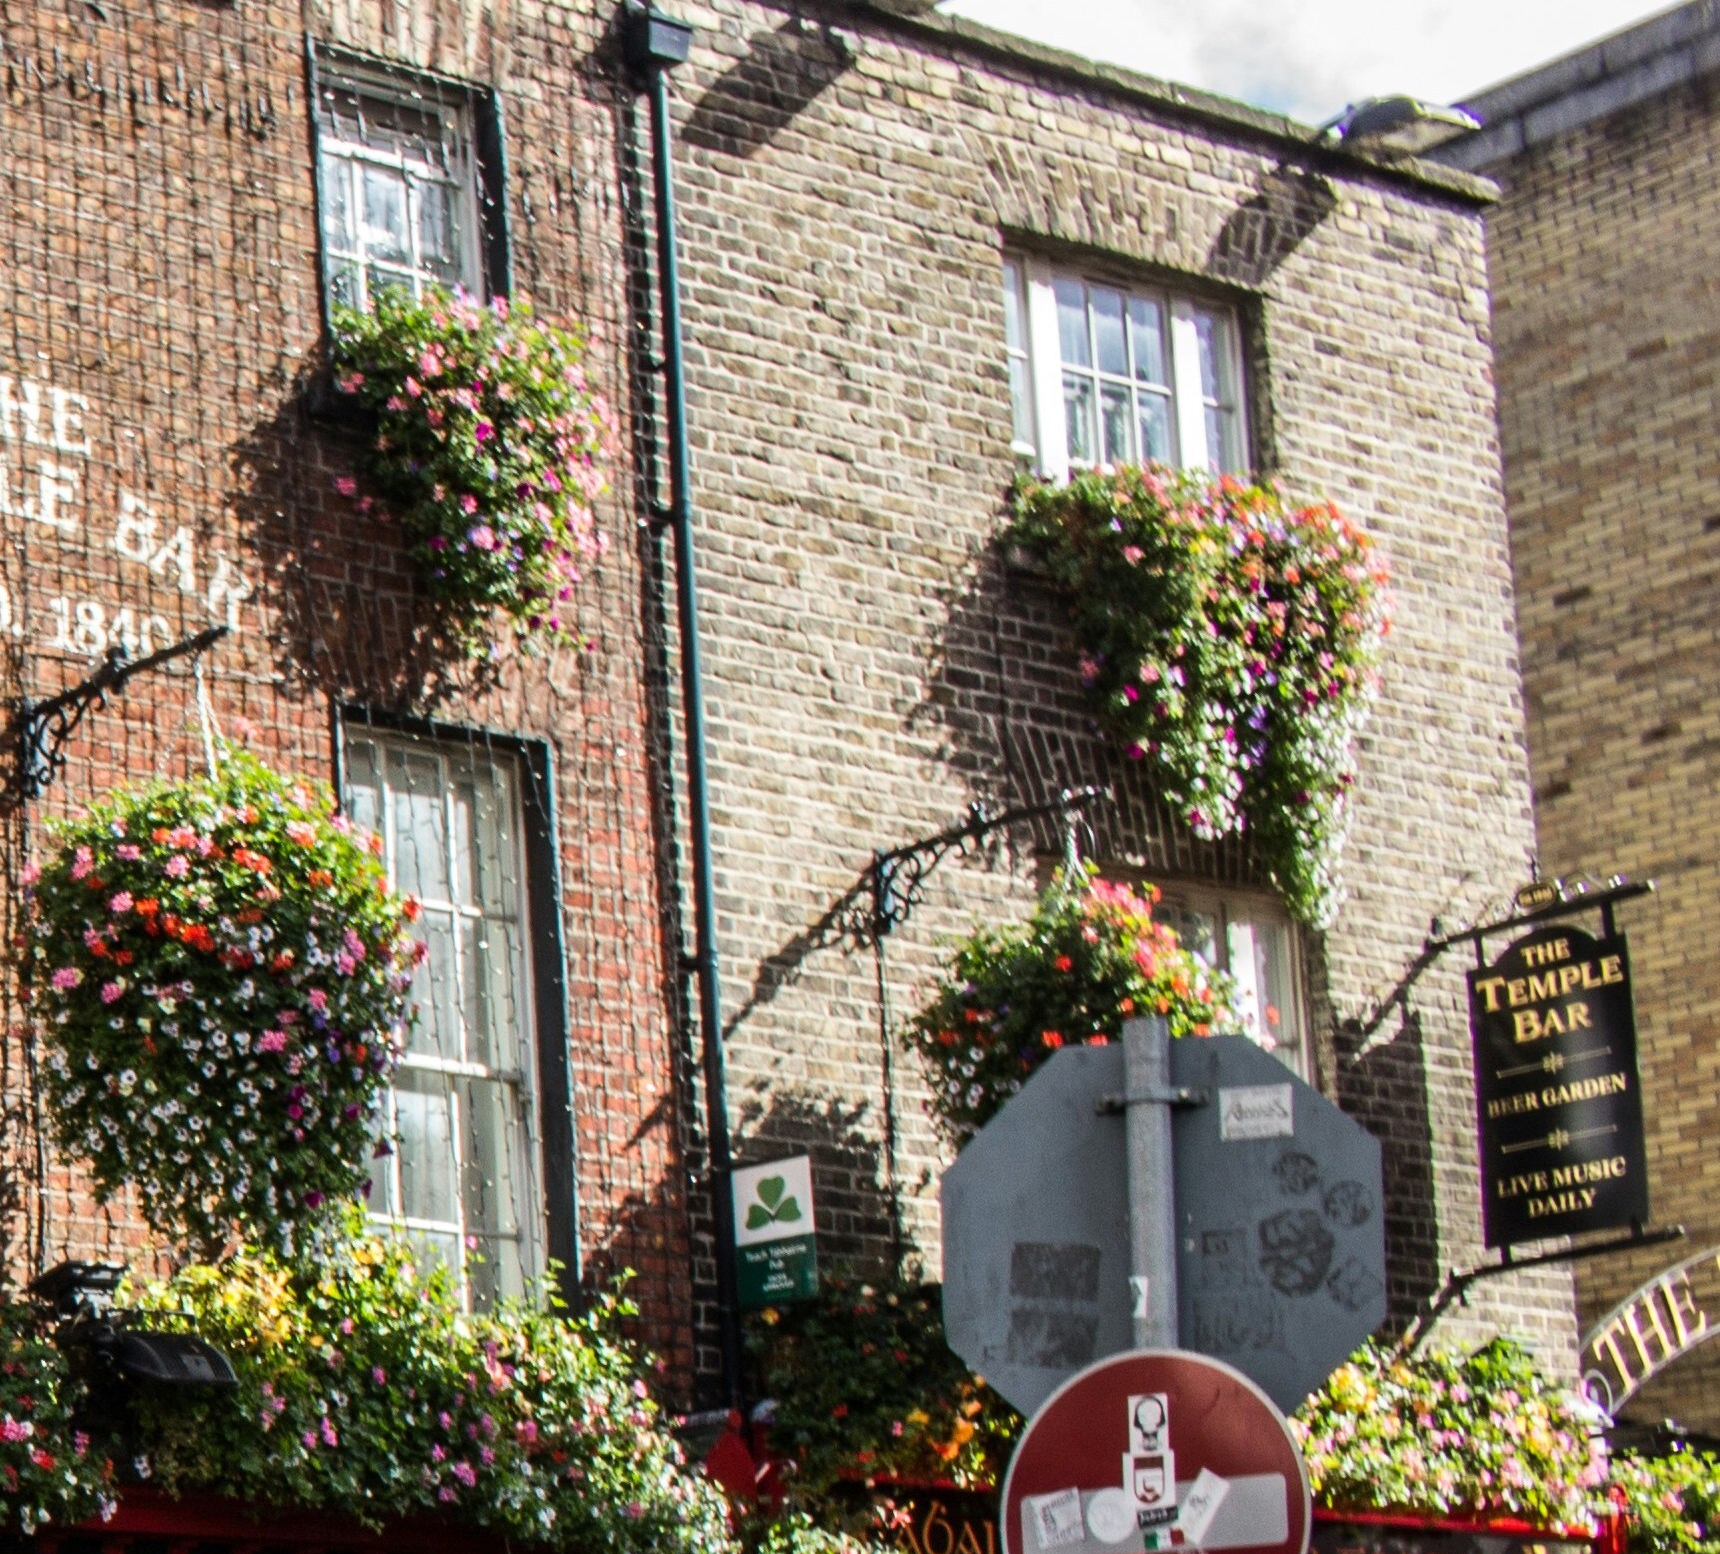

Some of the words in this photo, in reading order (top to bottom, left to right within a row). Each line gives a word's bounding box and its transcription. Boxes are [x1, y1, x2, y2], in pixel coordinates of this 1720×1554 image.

[112, 490, 253, 631] BAR
[1521, 939, 1570, 967] THE
[1475, 955, 1623, 1013] TEMPLE
[1512, 1002, 1592, 1043] BAR
[1487, 1092, 1539, 1118] BEER
[1542, 1073, 1626, 1108] GARDEN
[1497, 1170, 1547, 1198] LIVE
[1553, 1157, 1626, 1188] MUSIC
[1528, 1188, 1597, 1217] DAILY
[1593, 1269, 1706, 1393] THE
